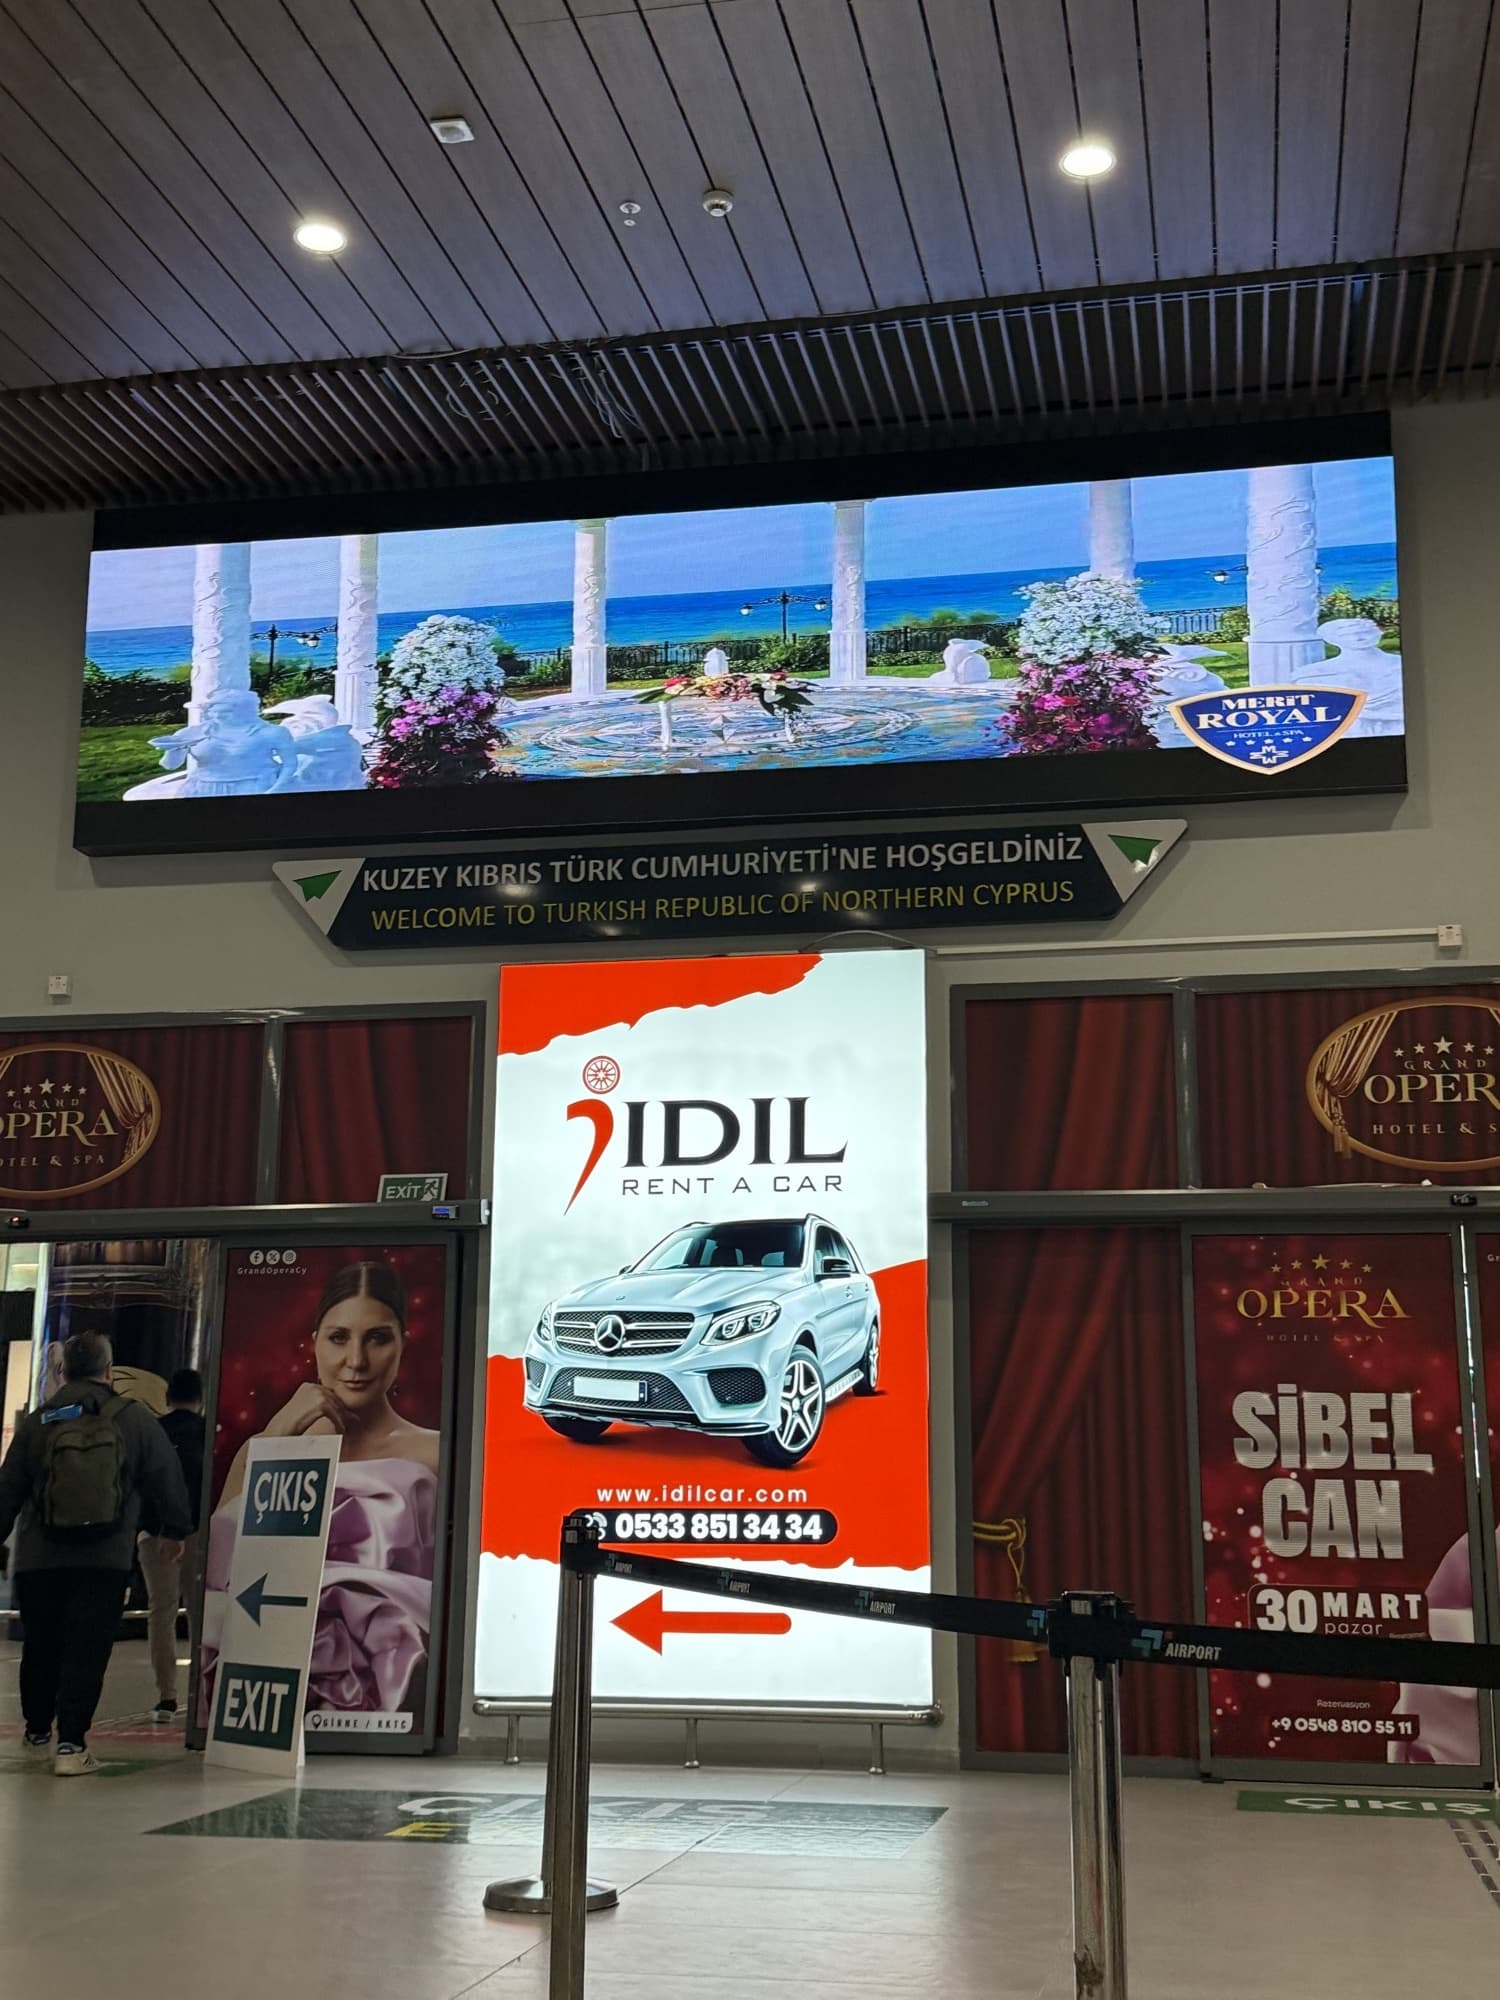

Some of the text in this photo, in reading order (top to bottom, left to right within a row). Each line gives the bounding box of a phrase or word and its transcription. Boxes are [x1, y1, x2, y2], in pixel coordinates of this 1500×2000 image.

[1197, 707, 1341, 729] ROYAL
[363, 832, 1083, 892] KUZEY KIBRIS TÜRK CUMHURİYETİ'NE HOŞGELDİNİZ
[372, 880, 1075, 931] WELCOME TO TURKISH REPUBLIC OF NORTHERN CYPRUS
[1404, 1059, 1486, 1071] GRAND
[1364, 1073, 1500, 1110] OPER
[13, 1099, 79, 1110] GRAND
[0, 1109, 118, 1147] PERA
[624, 1097, 847, 1167] IDIL
[1373, 1124, 1445, 1134] HOTEL
[1460, 1122, 1477, 1135] &
[50, 1155, 62, 1167] &
[73, 1154, 104, 1165] SPA
[623, 1175, 842, 1195] RENT A CAR
[1236, 1288, 1415, 1328] OPERA
[1232, 1384, 1434, 1473] SİBEL
[254, 1470, 319, 1524] ÇIKIŞ
[597, 1485, 808, 1503] www.idilcar.com
[615, 1513, 823, 1539] 0533 851 34 34
[1262, 1477, 1404, 1559] CAN
[869, 1600, 896, 1616] AIRPORT
[1256, 1588, 1422, 1633] 30 MART
[1324, 1622, 1383, 1635] pazar
[1165, 1642, 1222, 1661] AIRPORT
[223, 1679, 289, 1734] EXIT
[1316, 1699, 1371, 1709] Rezervasyon
[1272, 1717, 1412, 1735] +9 0548 810 55 11
[1285, 1797, 1491, 1815] ÇIKIŞ
